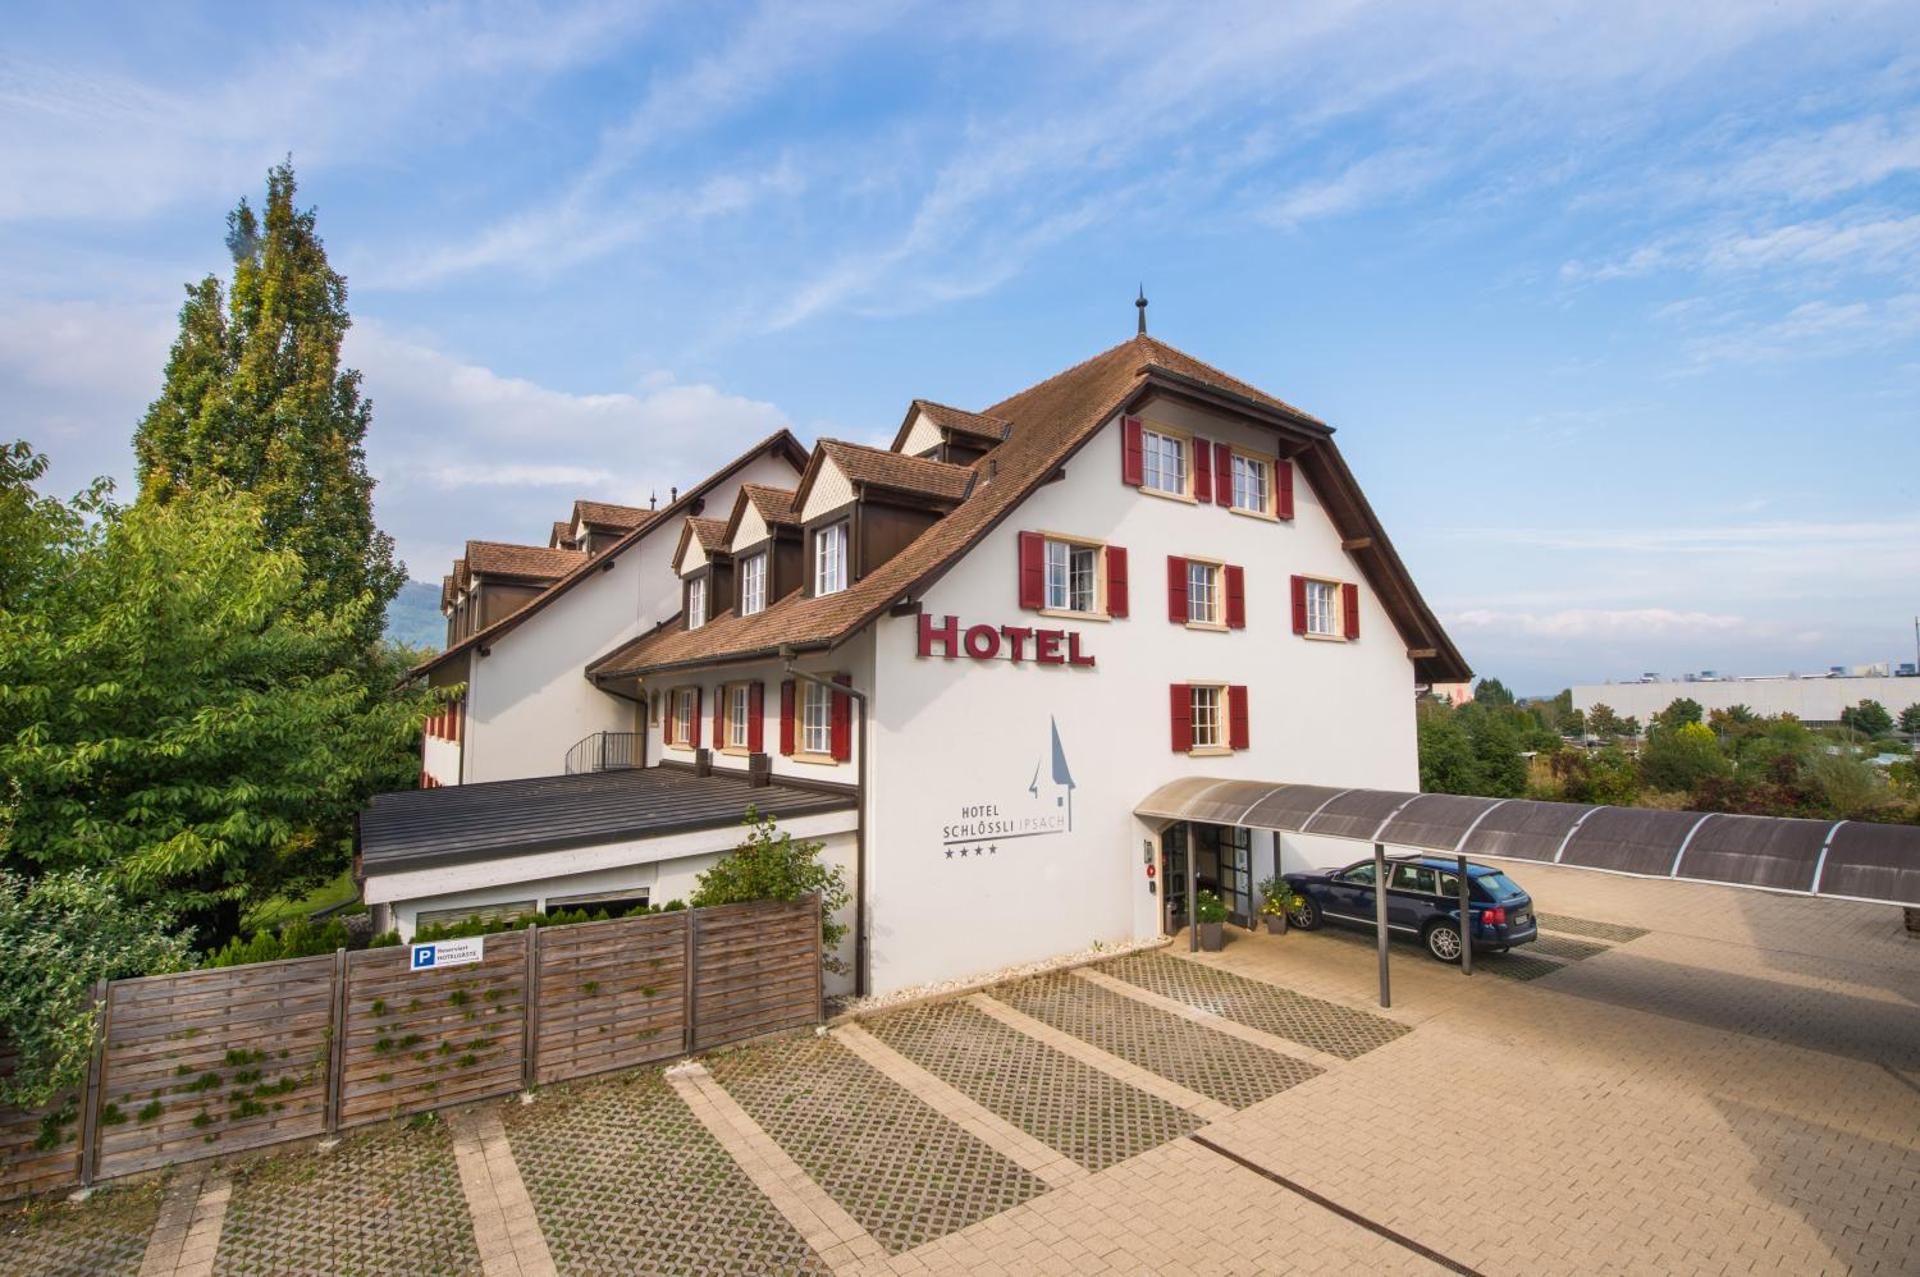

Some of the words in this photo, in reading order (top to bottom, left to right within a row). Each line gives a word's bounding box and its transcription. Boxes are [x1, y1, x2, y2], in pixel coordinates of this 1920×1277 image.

[918, 614, 1096, 666] HOTEL
[962, 805, 999, 819] HOTEL
[943, 820, 1014, 838] SCHLÖSSLI
[1019, 815, 1065, 830] IPSACH
[419, 951, 431, 964] P
